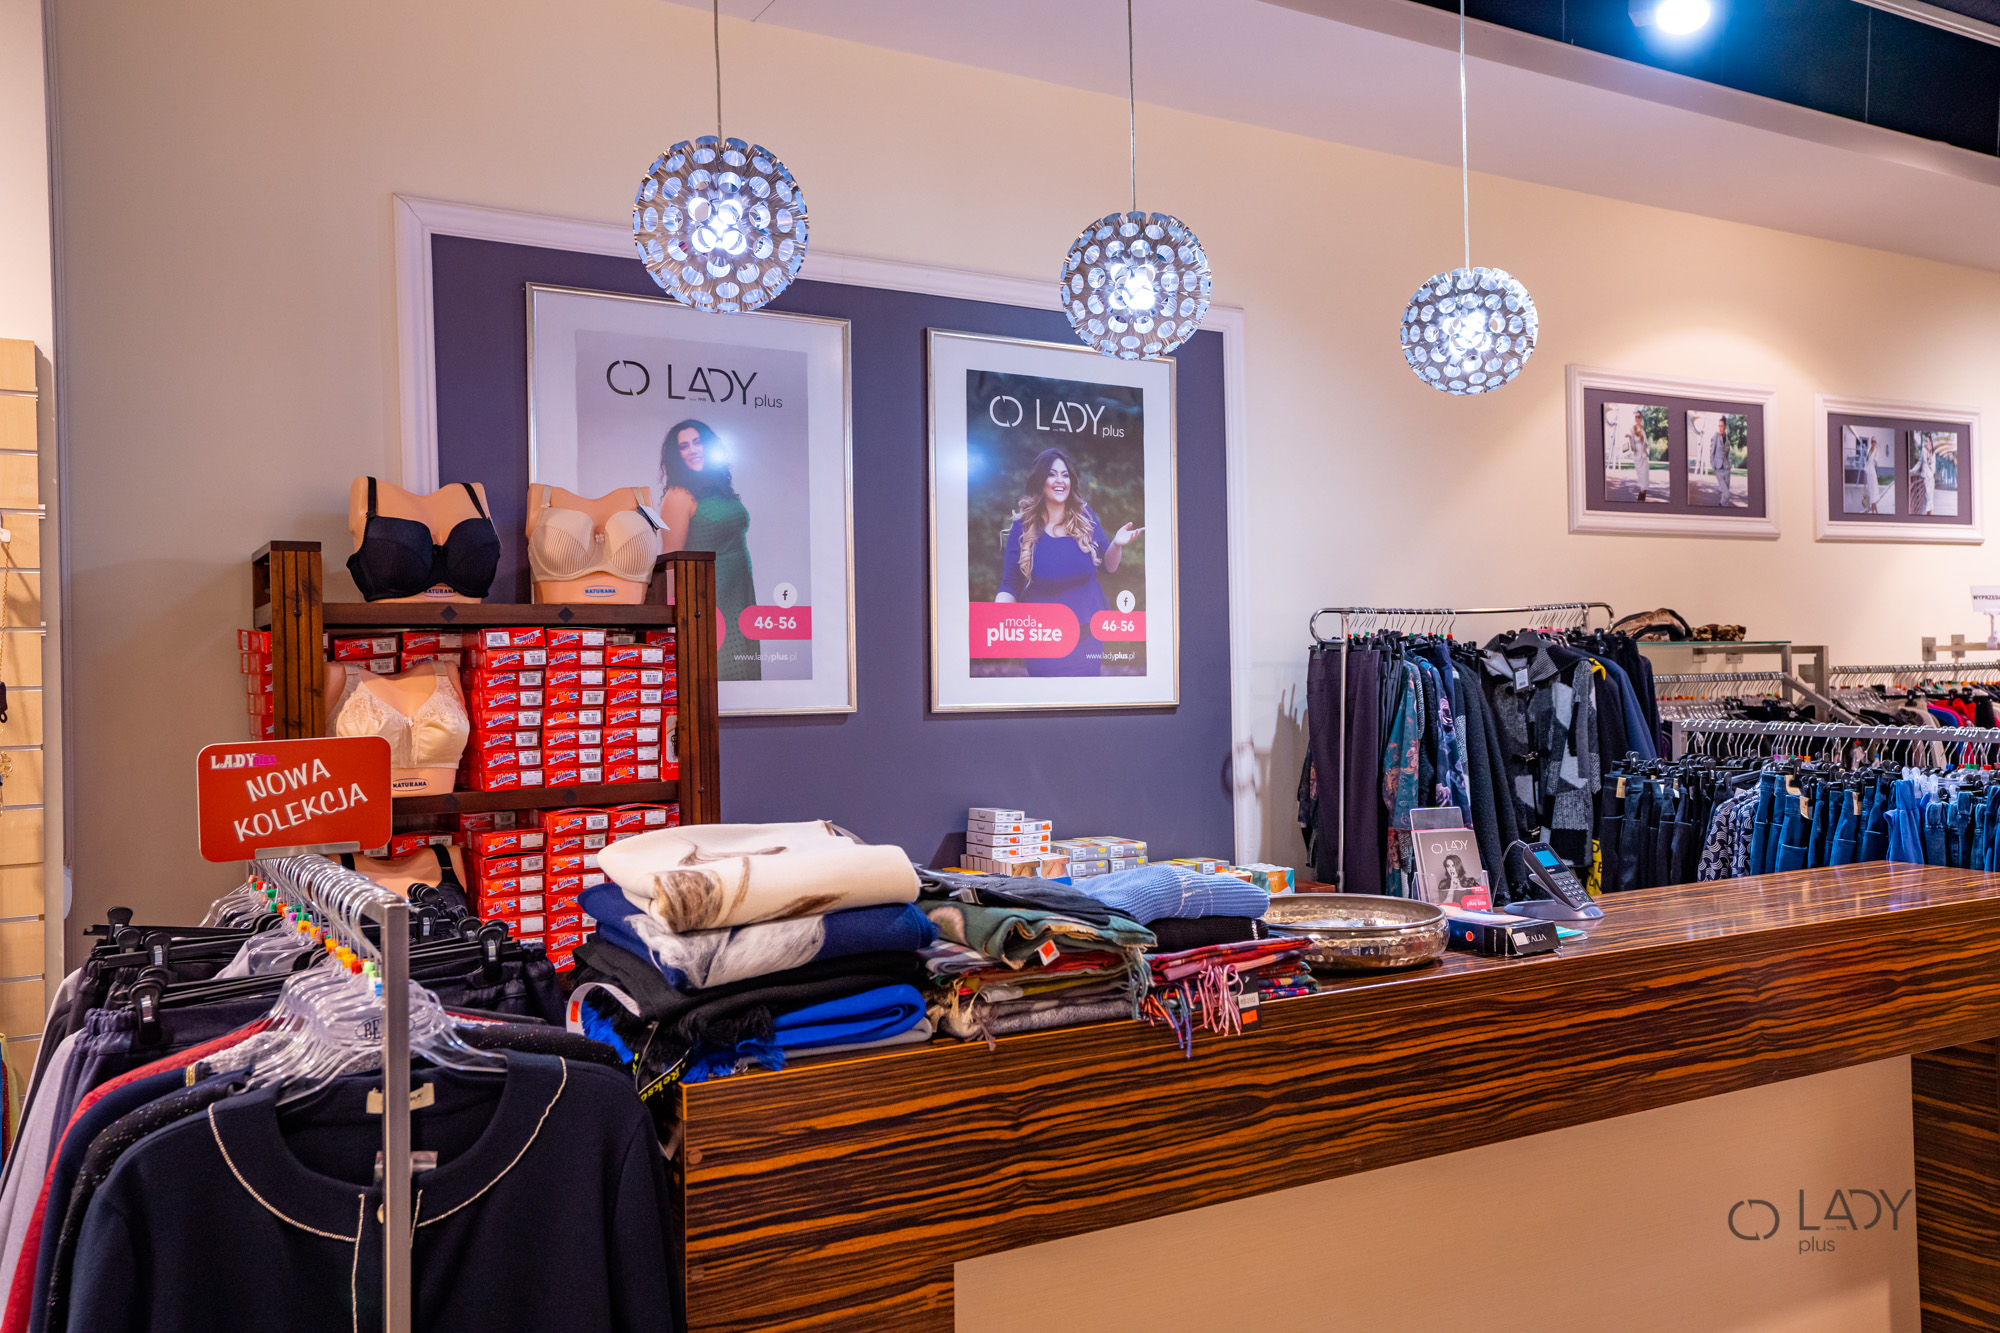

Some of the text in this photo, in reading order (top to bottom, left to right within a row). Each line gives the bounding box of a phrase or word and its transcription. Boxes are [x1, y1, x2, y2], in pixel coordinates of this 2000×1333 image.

[667, 363, 783, 409] LADY plus
[1036, 398, 1125, 438] LADY plus
[754, 616, 797, 630] 46-56
[1005, 615, 1037, 628] moda
[1101, 620, 1135, 632] 46-56
[986, 624, 1063, 646] plus size
[733, 651, 798, 663] www.ladyplus.pl
[1085, 651, 1136, 662] www.ladyplus.pl
[210, 753, 256, 769] LADY
[245, 758, 332, 802] NOWA
[233, 782, 369, 843] KOLEKCJA
[1444, 840, 1468, 851] LADY
